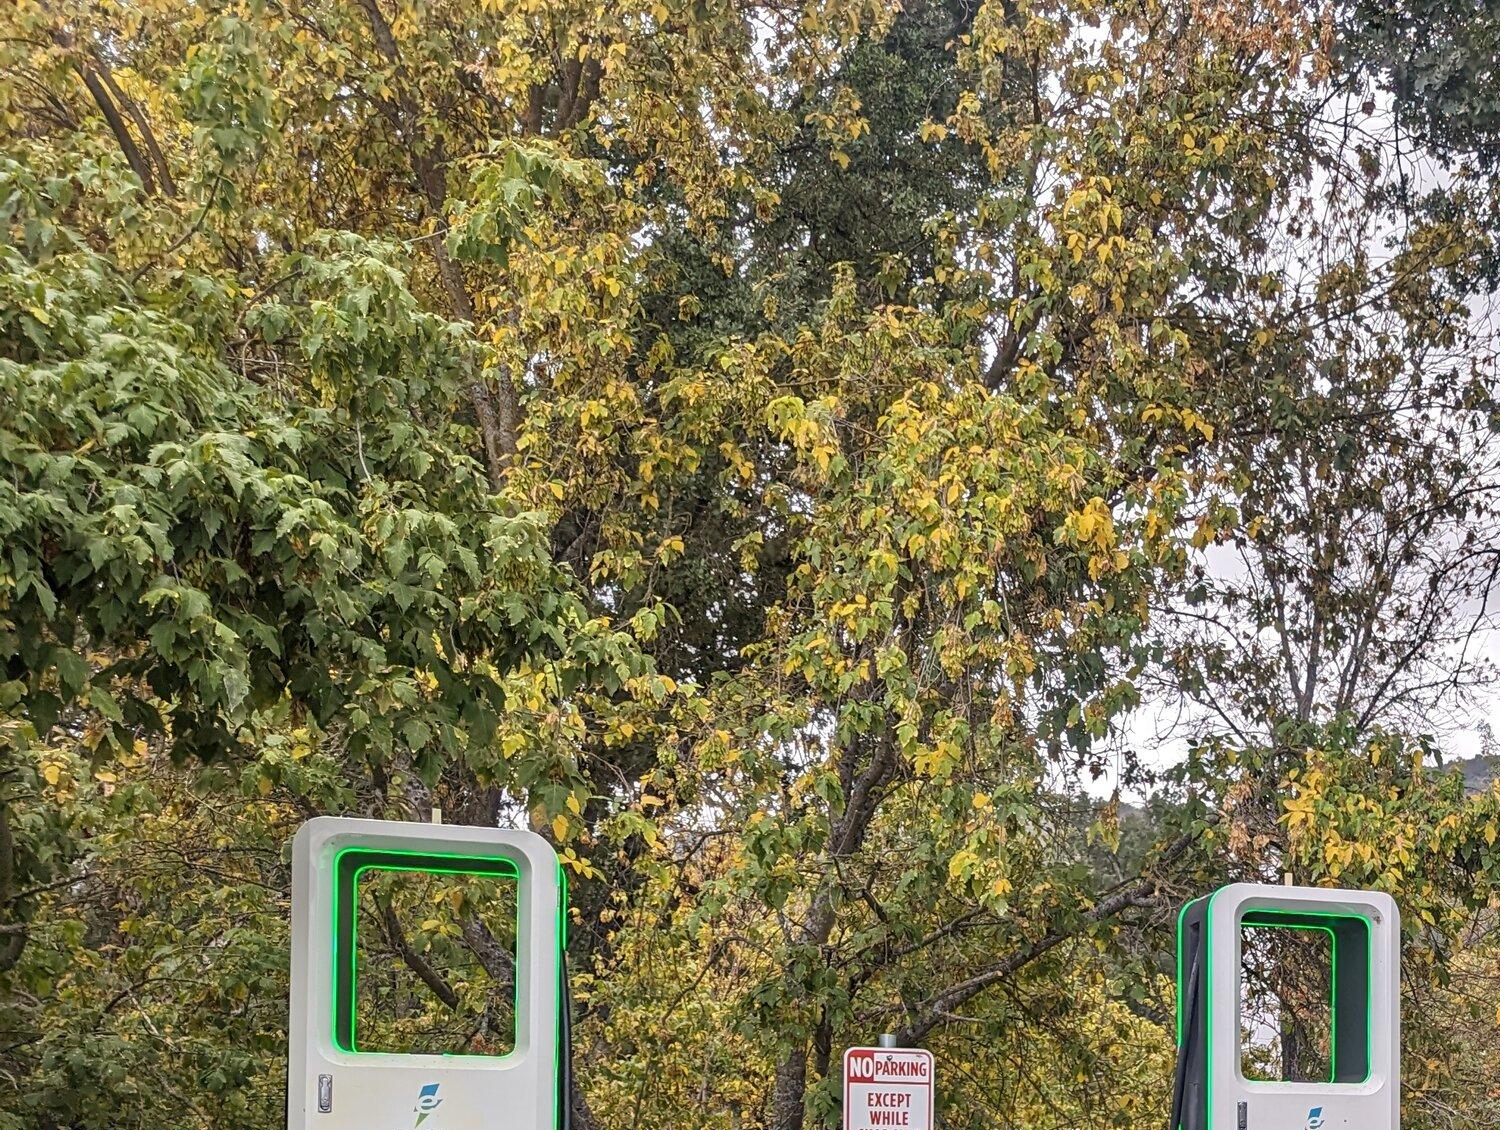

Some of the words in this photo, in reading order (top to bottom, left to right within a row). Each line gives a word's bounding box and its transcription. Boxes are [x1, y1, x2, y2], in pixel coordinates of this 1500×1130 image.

[850, 1057, 873, 1077] NO
[875, 1061, 927, 1076] PARKING
[867, 1093, 911, 1107] EXCEPT
[870, 1111, 908, 1125] WHILE
